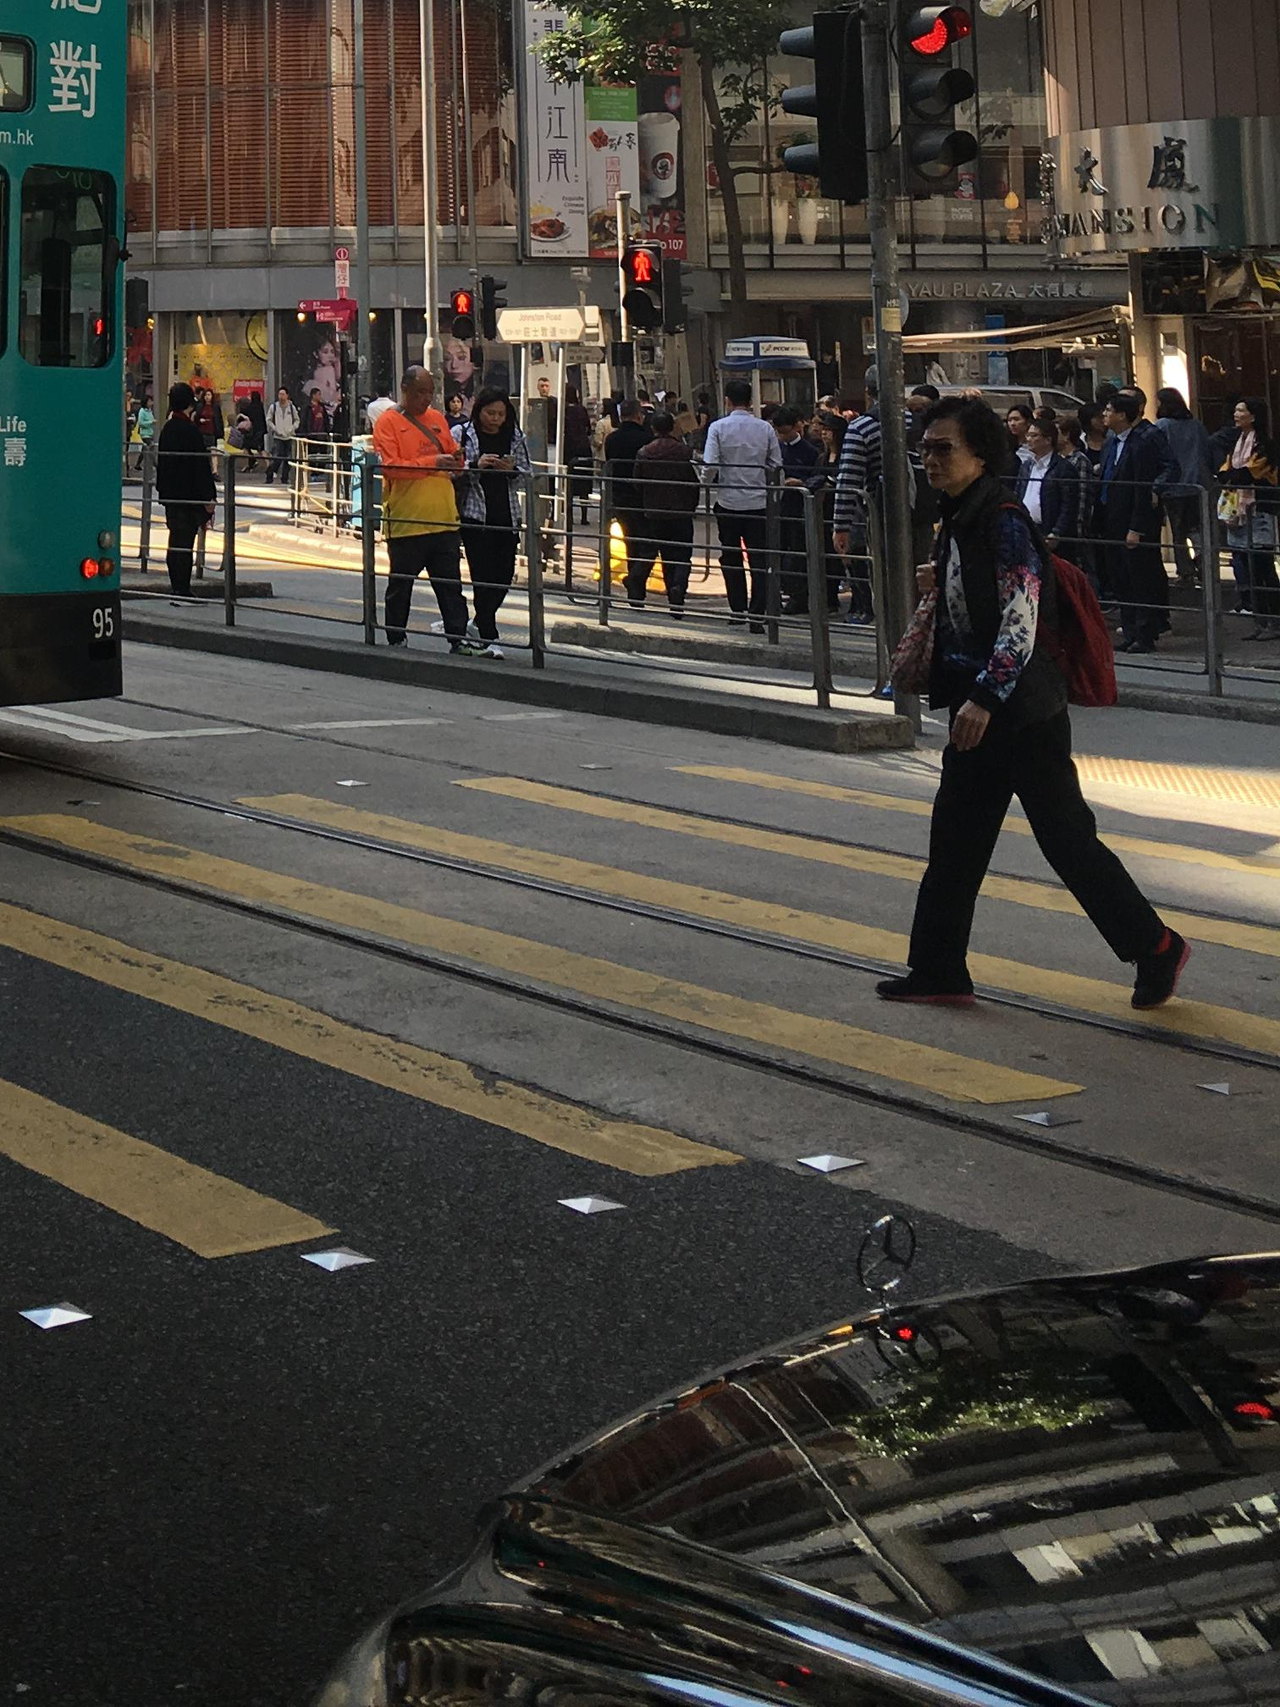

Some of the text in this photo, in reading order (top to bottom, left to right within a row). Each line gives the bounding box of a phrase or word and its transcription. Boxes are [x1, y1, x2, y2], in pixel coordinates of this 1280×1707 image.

[907, 282, 1017, 298] YAU PLAZA
[518, 313, 562, 322] Johnston Road
[92, 607, 114, 638] 95
